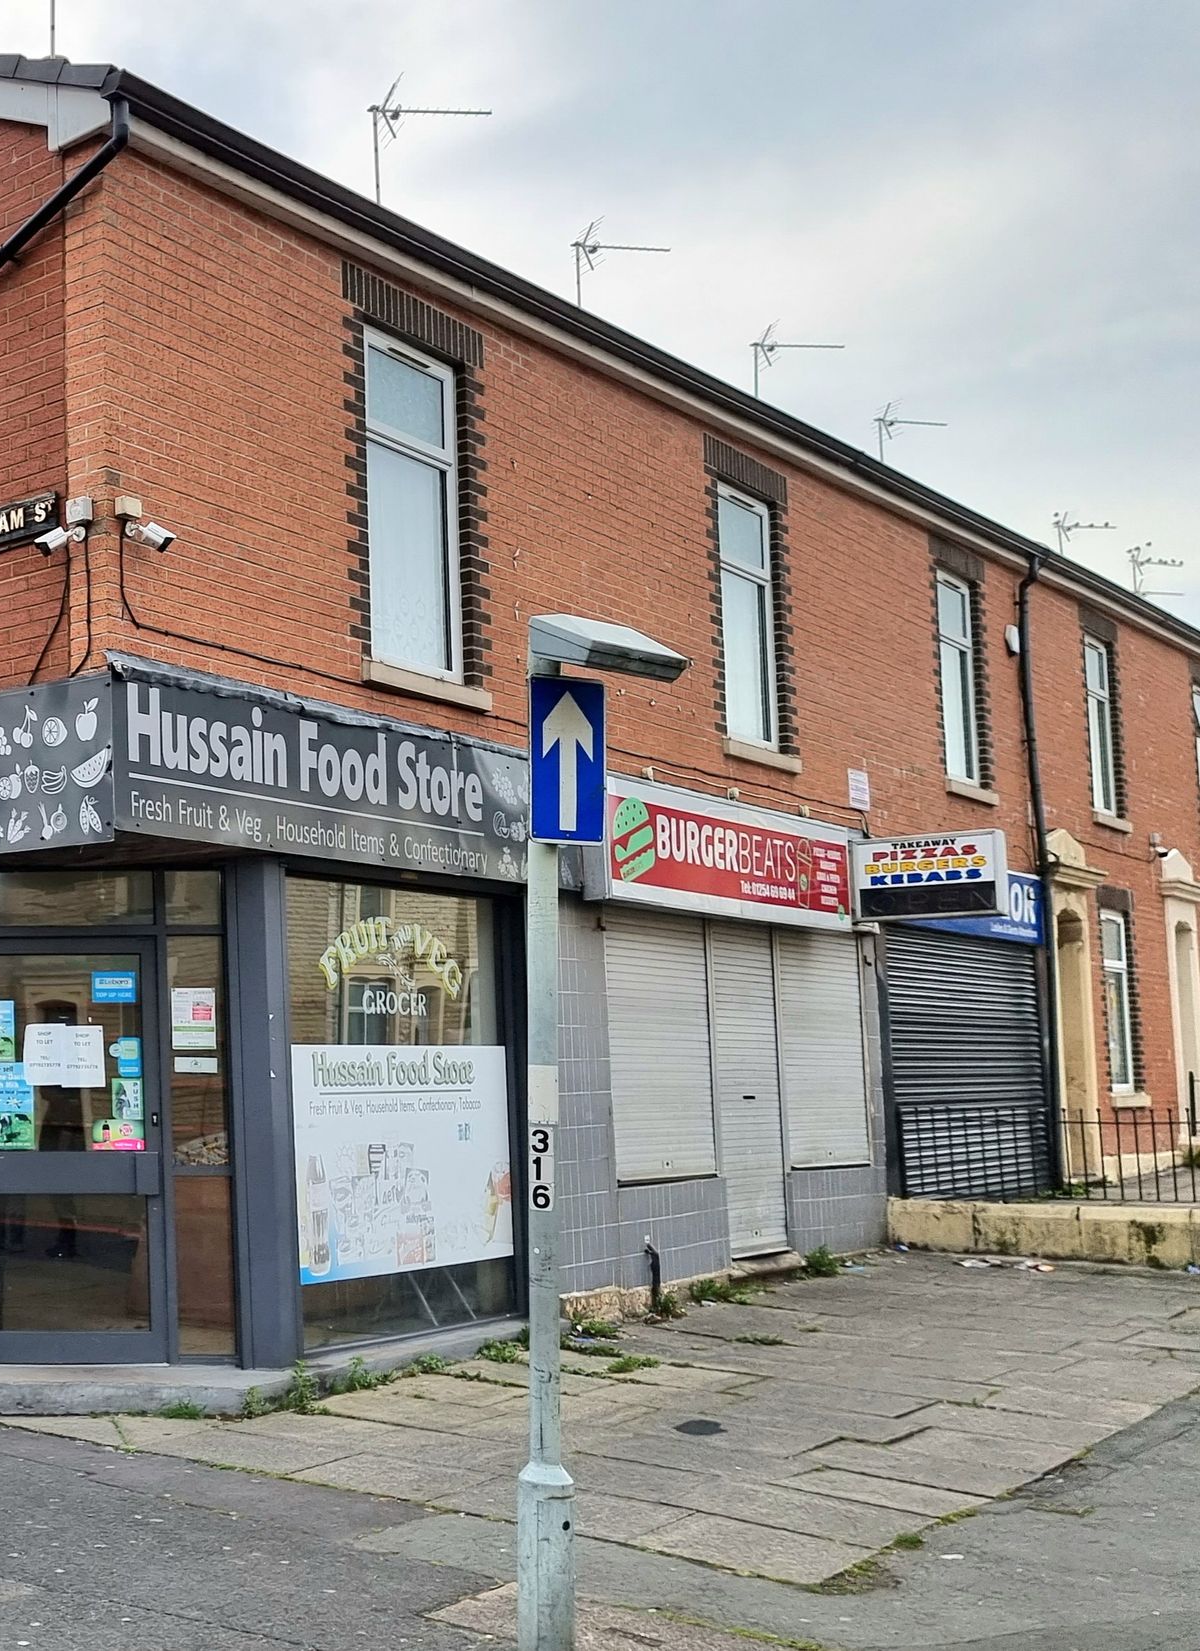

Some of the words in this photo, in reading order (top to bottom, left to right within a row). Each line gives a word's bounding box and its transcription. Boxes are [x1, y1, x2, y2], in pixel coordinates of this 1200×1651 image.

[127, 682, 288, 789] Hussain
[299, 719, 388, 805] Food
[397, 740, 484, 822] Store
[130, 790, 172, 823] Fresh
[178, 799, 214, 830] Fruit
[218, 805, 231, 832] &
[276, 815, 346, 850] Household
[351, 827, 385, 856] Items
[389, 833, 400, 857] &
[404, 836, 488, 875] Confectionary
[891, 838, 957, 850] TAKEAWAY
[864, 855, 987, 875] BURGERS
[872, 844, 978, 863] PIZZAS
[870, 868, 982, 886] KEBABS
[319, 916, 392, 990] FRUIT
[412, 923, 463, 1000] VEG
[362, 989, 427, 1017] GROCER
[311, 1051, 385, 1087] Hussain
[386, 1050, 432, 1087] Food
[432, 1050, 476, 1087] Store
[309, 1100, 327, 1116] Fresh
[328, 1099, 343, 1115] Fruit
[366, 1098, 399, 1113] Household
